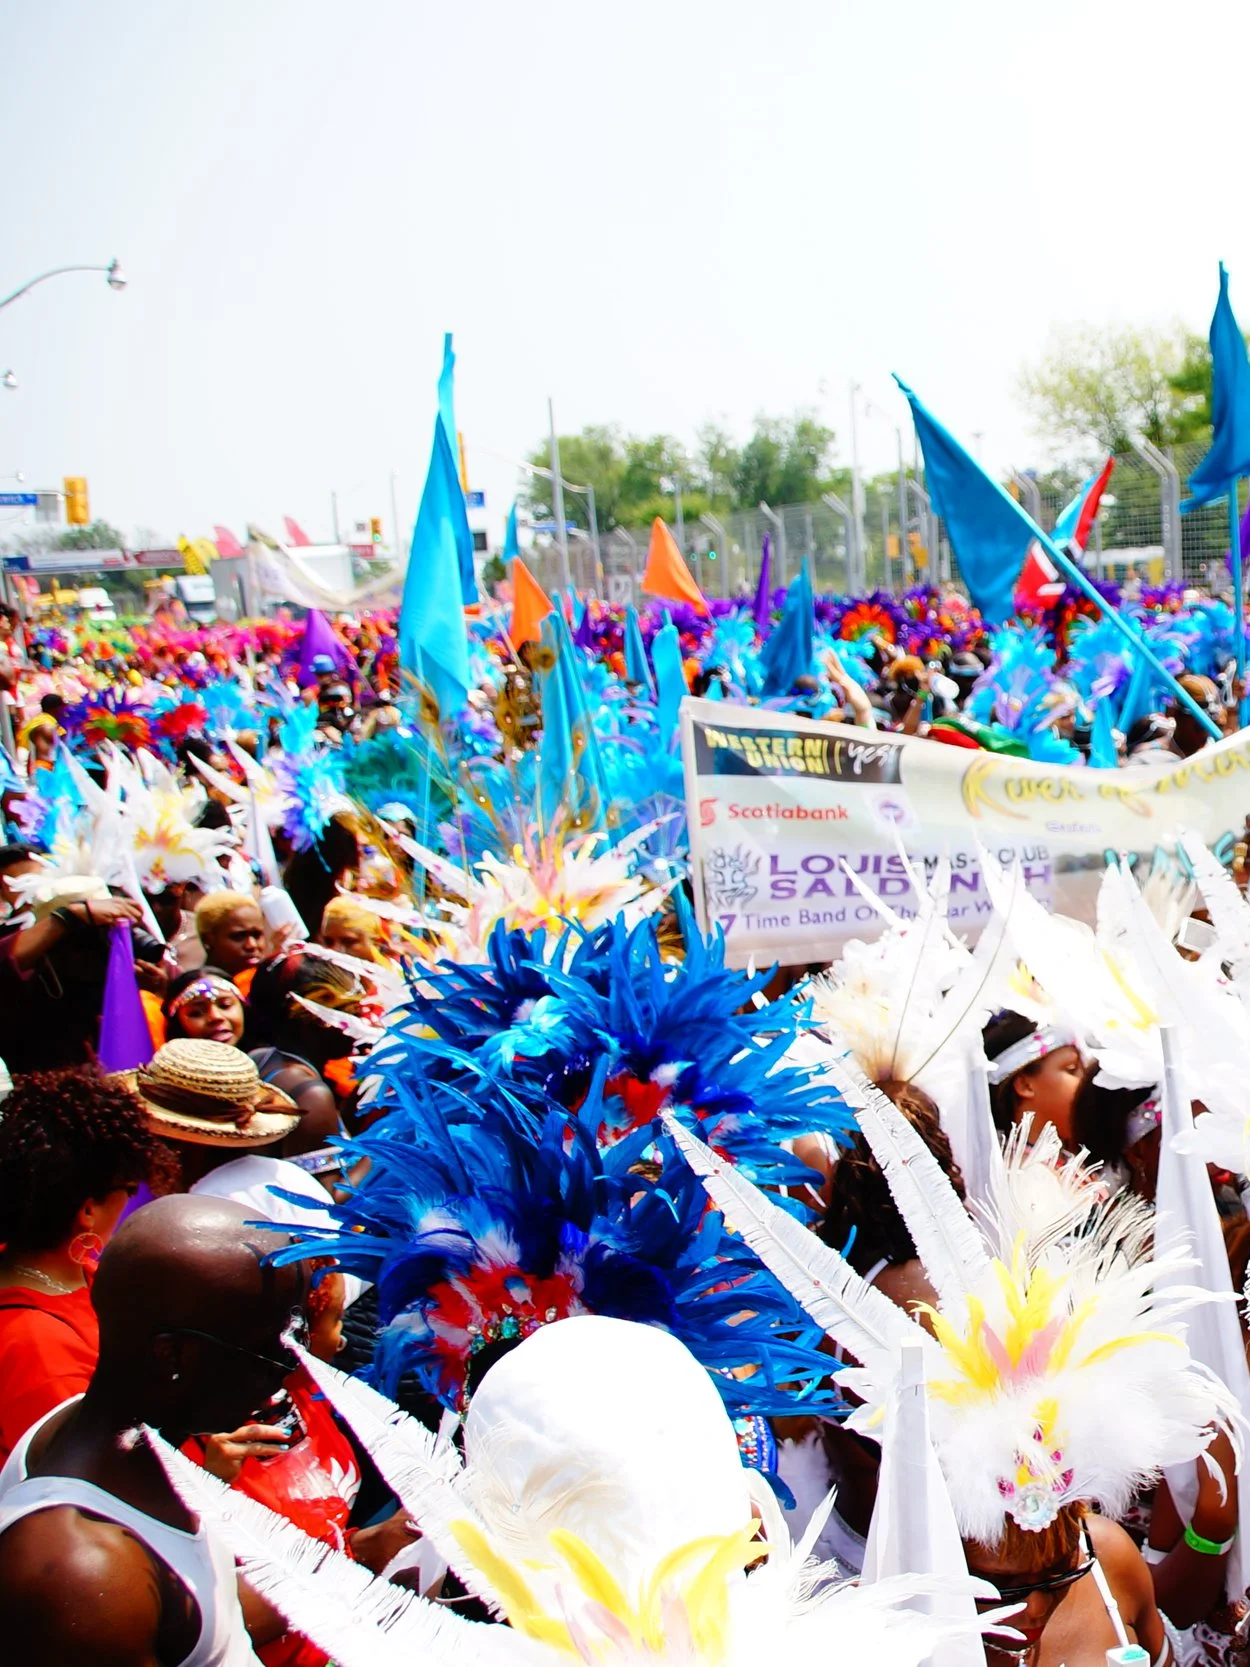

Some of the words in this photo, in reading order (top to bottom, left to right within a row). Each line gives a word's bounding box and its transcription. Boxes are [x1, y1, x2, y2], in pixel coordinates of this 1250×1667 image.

[703, 727, 823, 757] WESTERN
[745, 750, 826, 776] UNION
[728, 802, 849, 821] Scotiabank
[769, 853, 912, 876] LOUIS
[719, 913, 737, 936] 7
[743, 911, 791, 931] Time
[799, 906, 846, 925] Band
